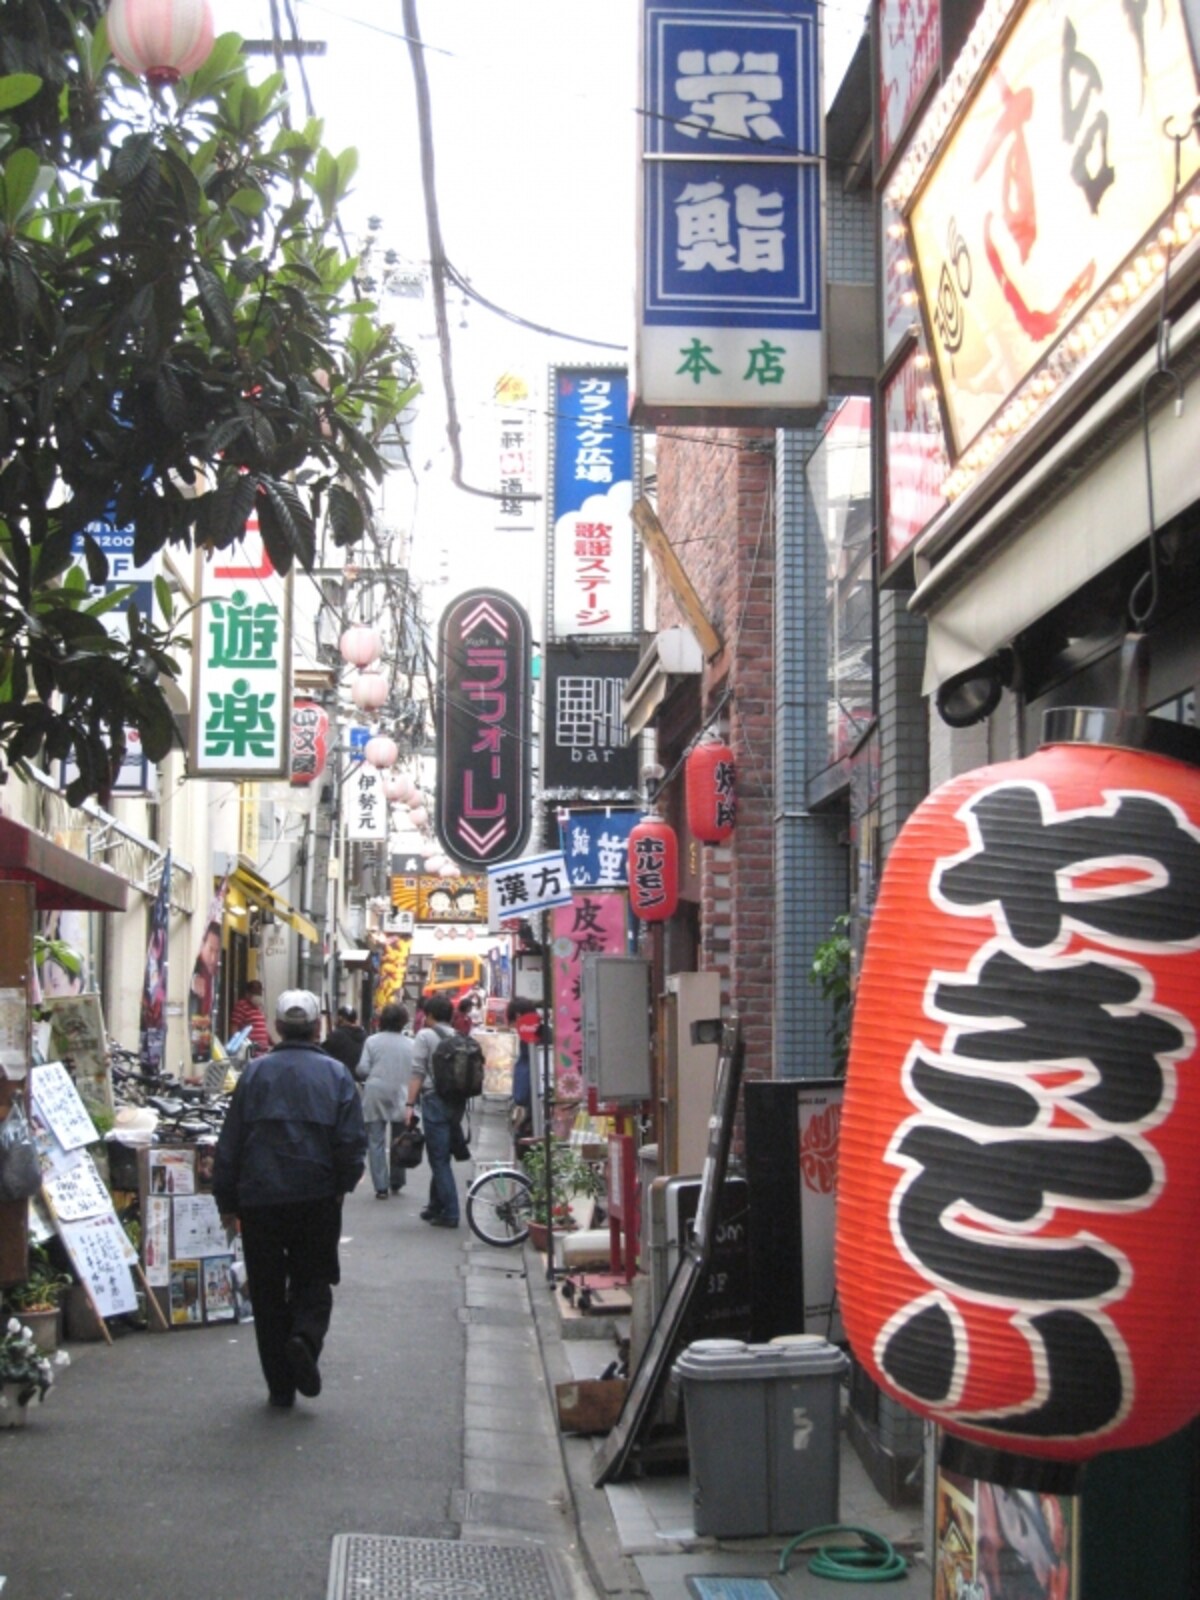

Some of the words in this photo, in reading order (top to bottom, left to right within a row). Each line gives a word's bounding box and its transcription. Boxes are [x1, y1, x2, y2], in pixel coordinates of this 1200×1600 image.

[674, 50, 786, 272] 栄鮨
[676, 338, 787, 386] 本店
[574, 378, 614, 483] カラオケ広場
[574, 521, 613, 626] 歌謡ステージ
[205, 589, 278, 757] 遊楽
[460, 648, 507, 818] ラフォーレ
[571, 746, 615, 763] bar
[357, 774, 378, 830] 伊勢元
[494, 865, 563, 909] 漢方
[635, 836, 666, 908] ホルモン
[874, 778, 1200, 1441] やきとり
